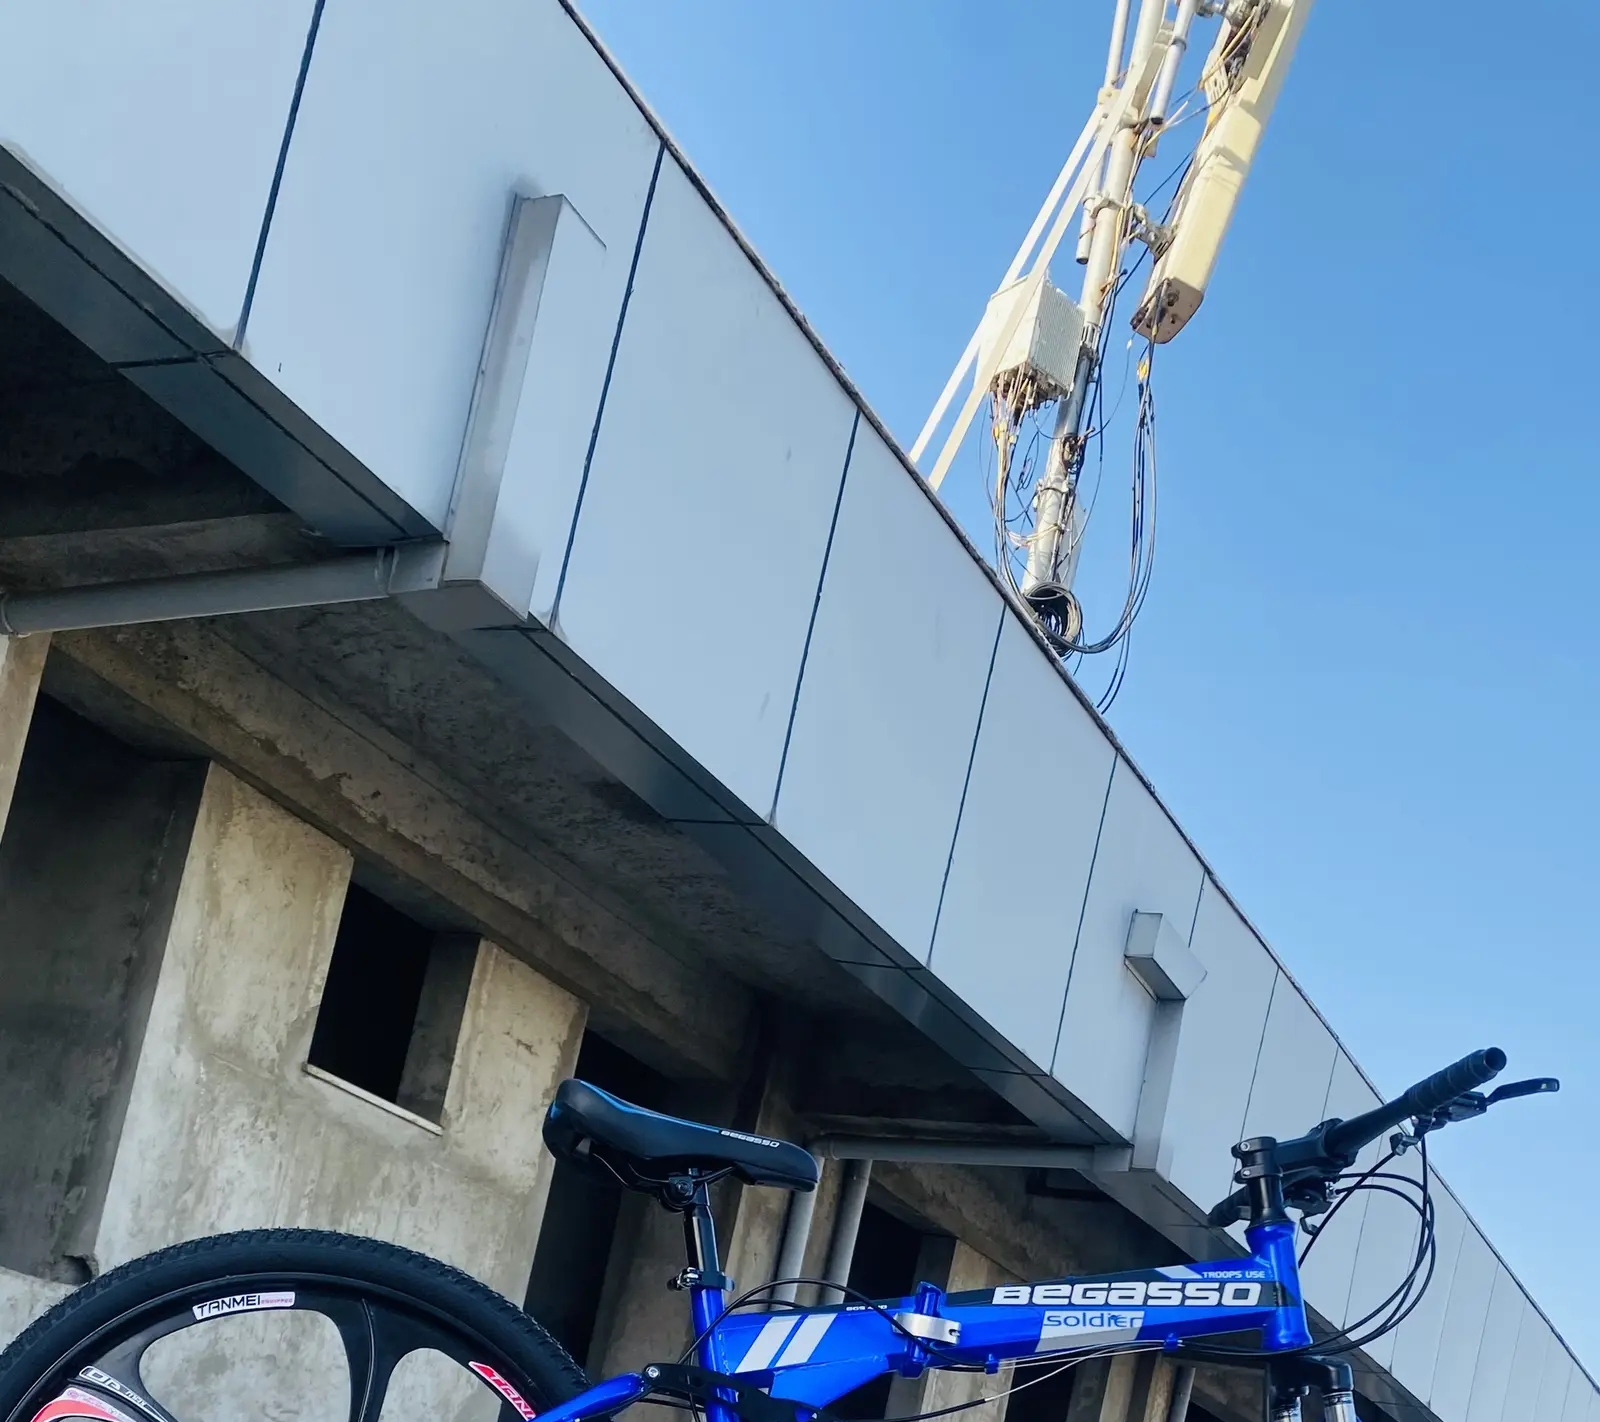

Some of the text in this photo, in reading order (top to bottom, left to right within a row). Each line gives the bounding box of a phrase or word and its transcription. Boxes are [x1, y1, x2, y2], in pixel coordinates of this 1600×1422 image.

[1202, 1269, 1266, 1279] TROOPS USE
[197, 1294, 260, 1317] TANMEI
[1043, 1312, 1144, 1328] soldier
